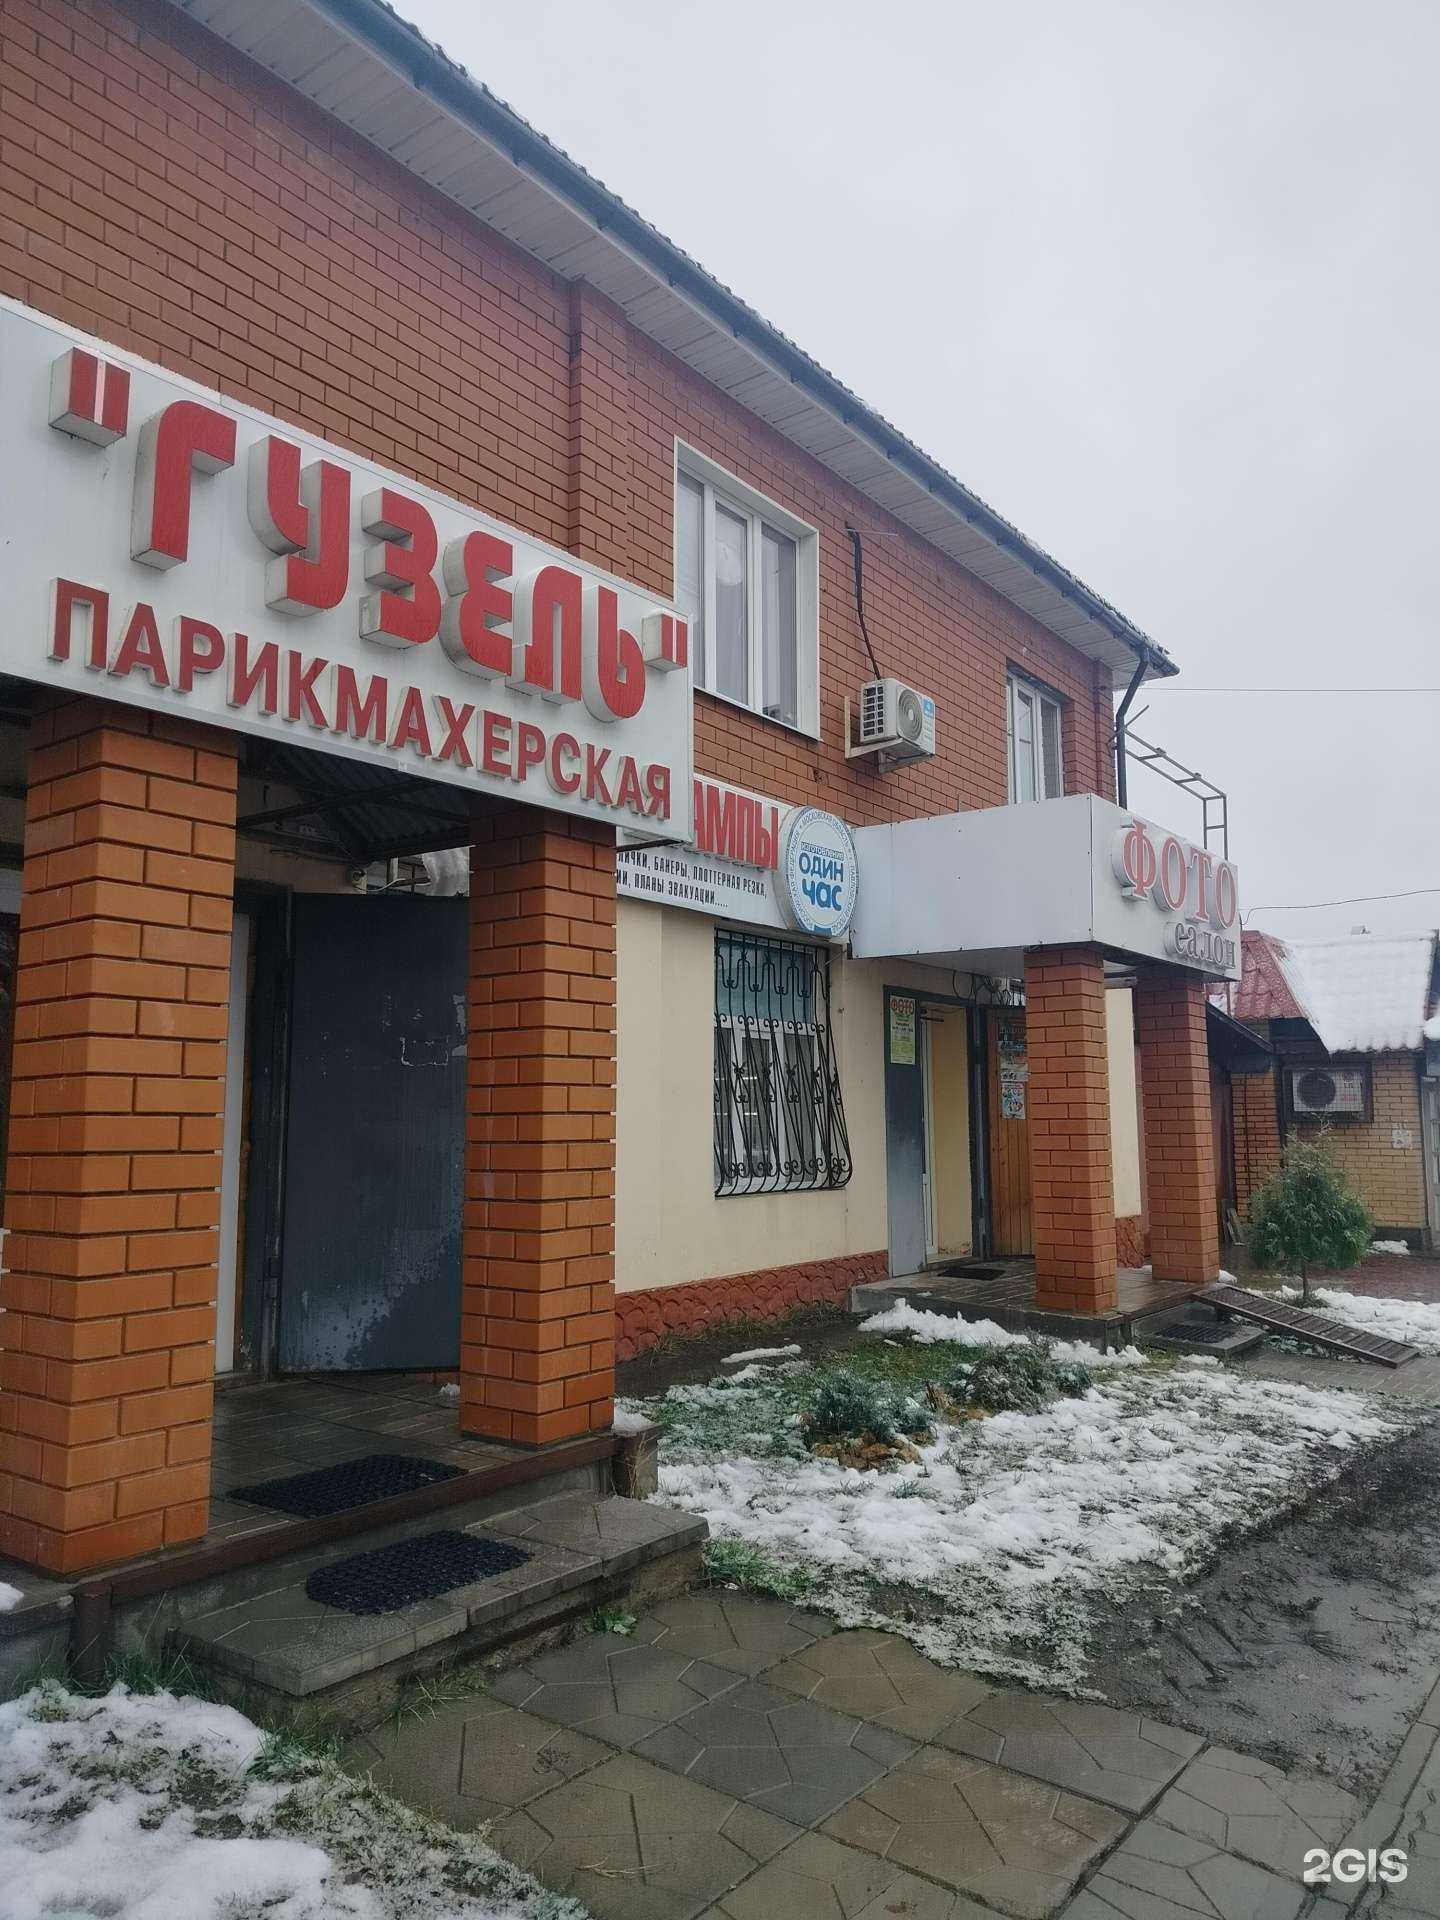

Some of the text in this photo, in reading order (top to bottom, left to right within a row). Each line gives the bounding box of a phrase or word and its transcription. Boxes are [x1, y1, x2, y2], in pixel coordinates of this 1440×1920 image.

[52, 345, 688, 723] "ГУЗЕЛЬ"
[49, 577, 672, 821] ПАРИКМАХЕРСКАЯ
[634, 873, 664, 893] ПЛАНЫ
[654, 856, 690, 881] БАНЕРЫ,
[693, 865, 740, 890] ПЛОТТЕРНАЯ
[743, 878, 767, 900] РЕЗКА,
[1115, 817, 1237, 929] ФОТО
